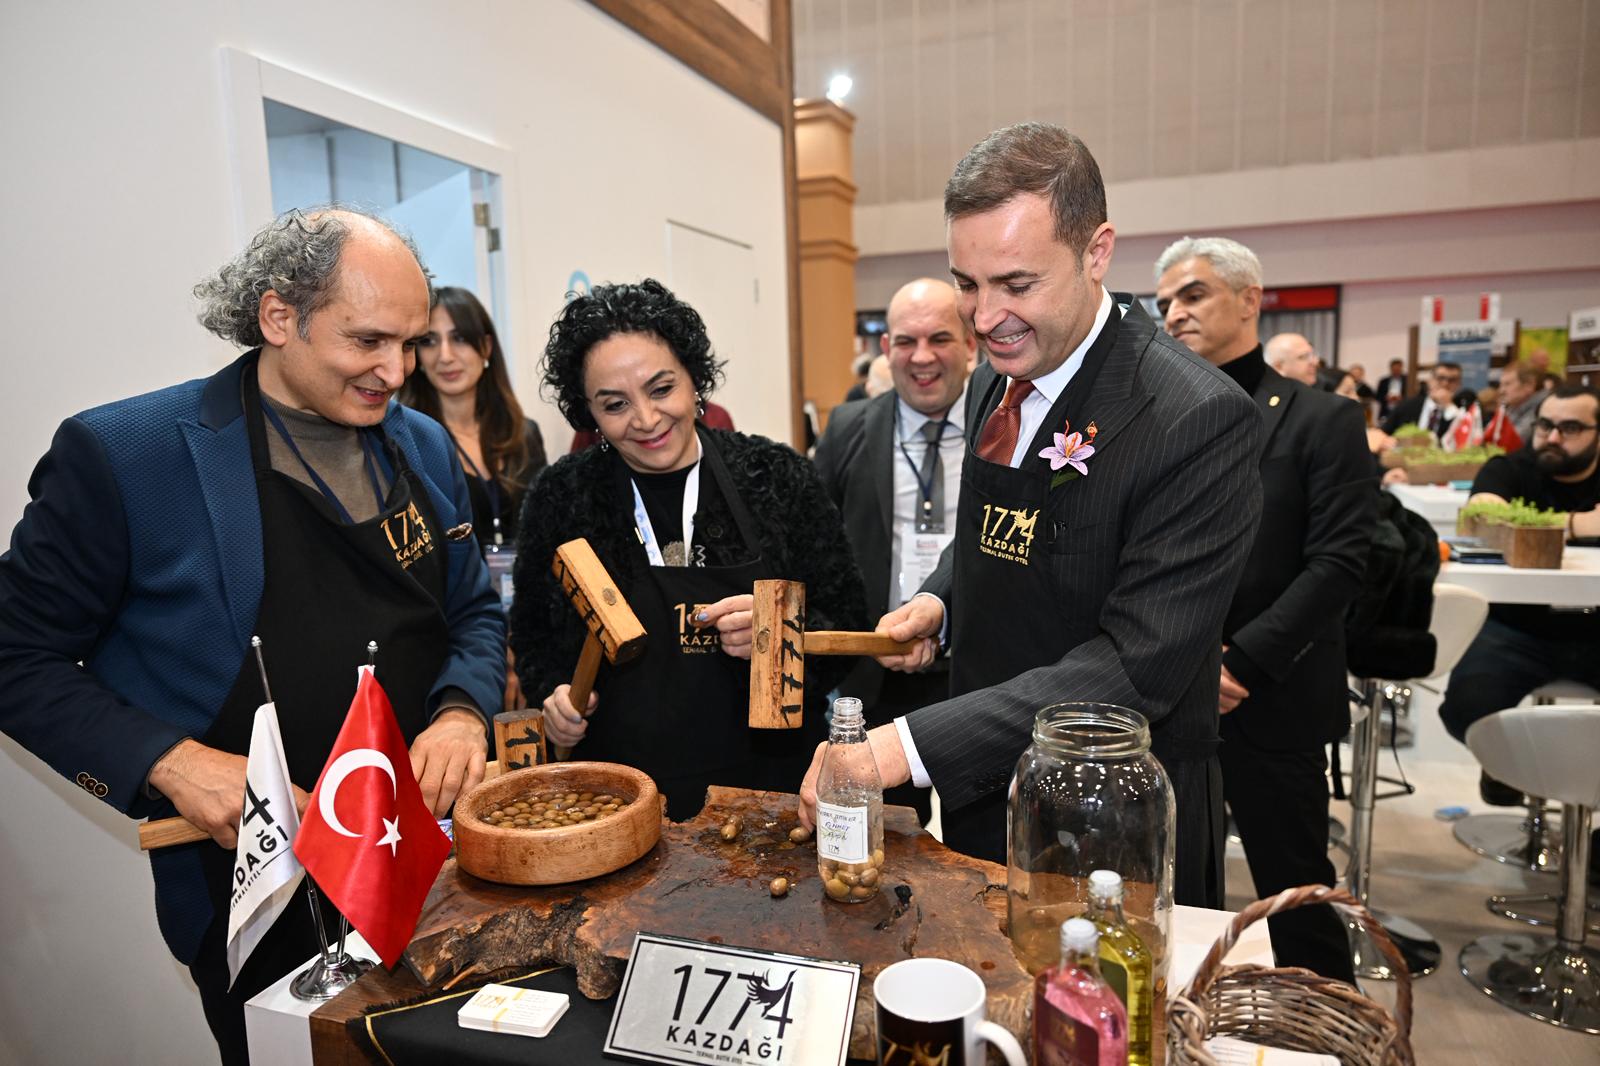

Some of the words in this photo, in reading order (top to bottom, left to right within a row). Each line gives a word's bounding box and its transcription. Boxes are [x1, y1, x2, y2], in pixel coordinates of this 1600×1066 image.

[380, 500, 427, 550] 174
[980, 533, 1030, 558] KAZDAĞI
[983, 504, 1040, 547] 1774
[672, 964, 798, 1039] 1774
[665, 1025, 783, 1062] KAZDAĞI
